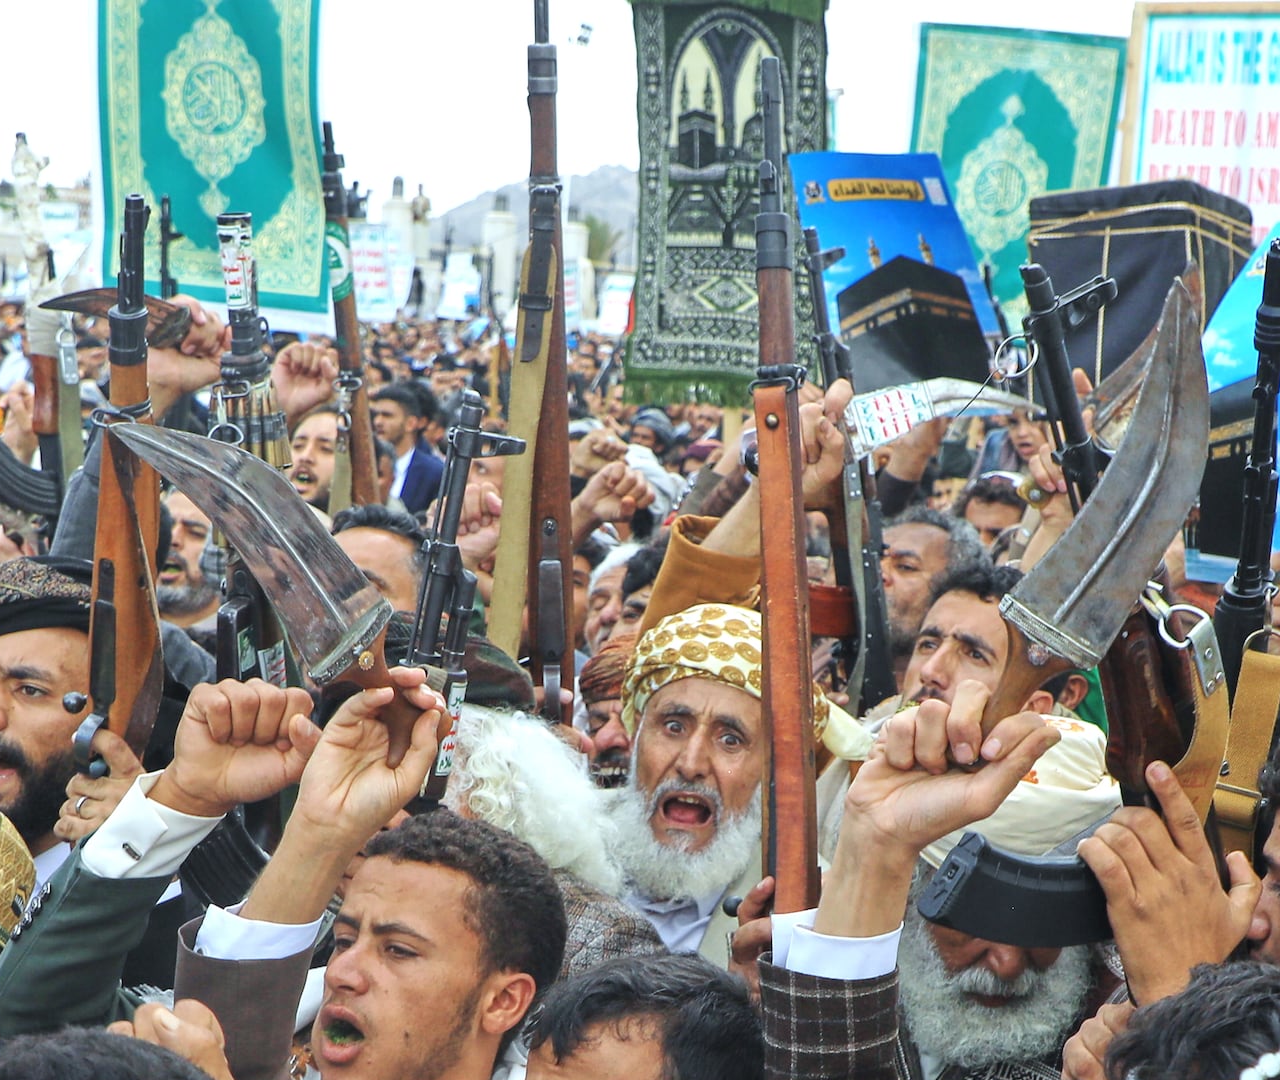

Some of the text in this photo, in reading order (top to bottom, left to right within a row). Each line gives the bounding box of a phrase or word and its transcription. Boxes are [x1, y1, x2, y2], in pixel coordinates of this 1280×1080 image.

[1153, 30, 1204, 84] ALLAH
[1211, 30, 1226, 84] IS
[1232, 31, 1263, 84] THE
[1151, 108, 1216, 147] DEATH
[1224, 110, 1247, 147] TO
[1219, 165, 1242, 200] TO
